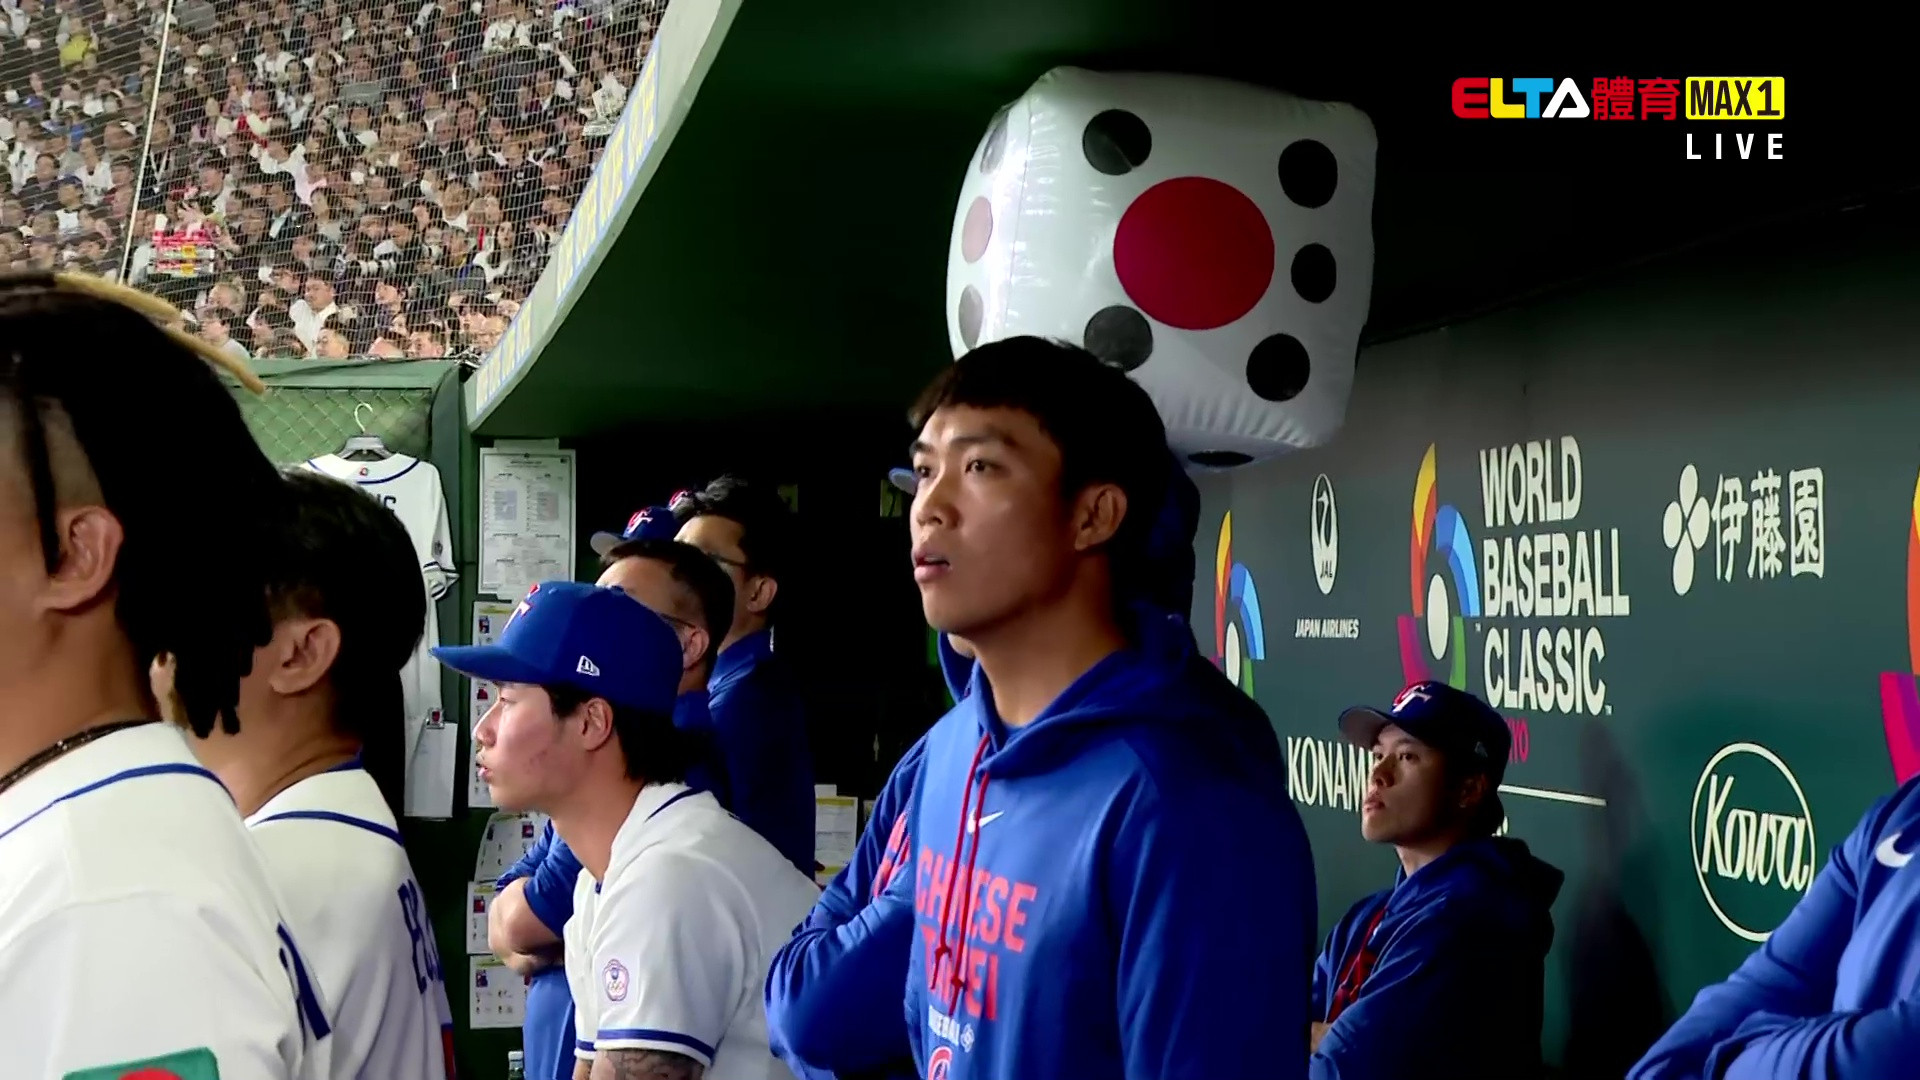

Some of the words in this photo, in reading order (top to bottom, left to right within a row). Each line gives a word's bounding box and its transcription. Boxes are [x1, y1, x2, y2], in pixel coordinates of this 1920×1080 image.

[1479, 435, 1582, 528] WORLD
[1711, 467, 1824, 583] 伊藤園
[1320, 559, 1333, 579] JAL
[1483, 527, 1630, 617] BASEBALL
[1295, 618, 1320, 638] JAPAN
[1321, 618, 1360, 639] AIRLINES
[1484, 626, 1606, 716] CLASSIC
[1701, 773, 1810, 892] Kowa
[915, 845, 1038, 953] CHNESE
[921, 925, 999, 1021] TAEI
